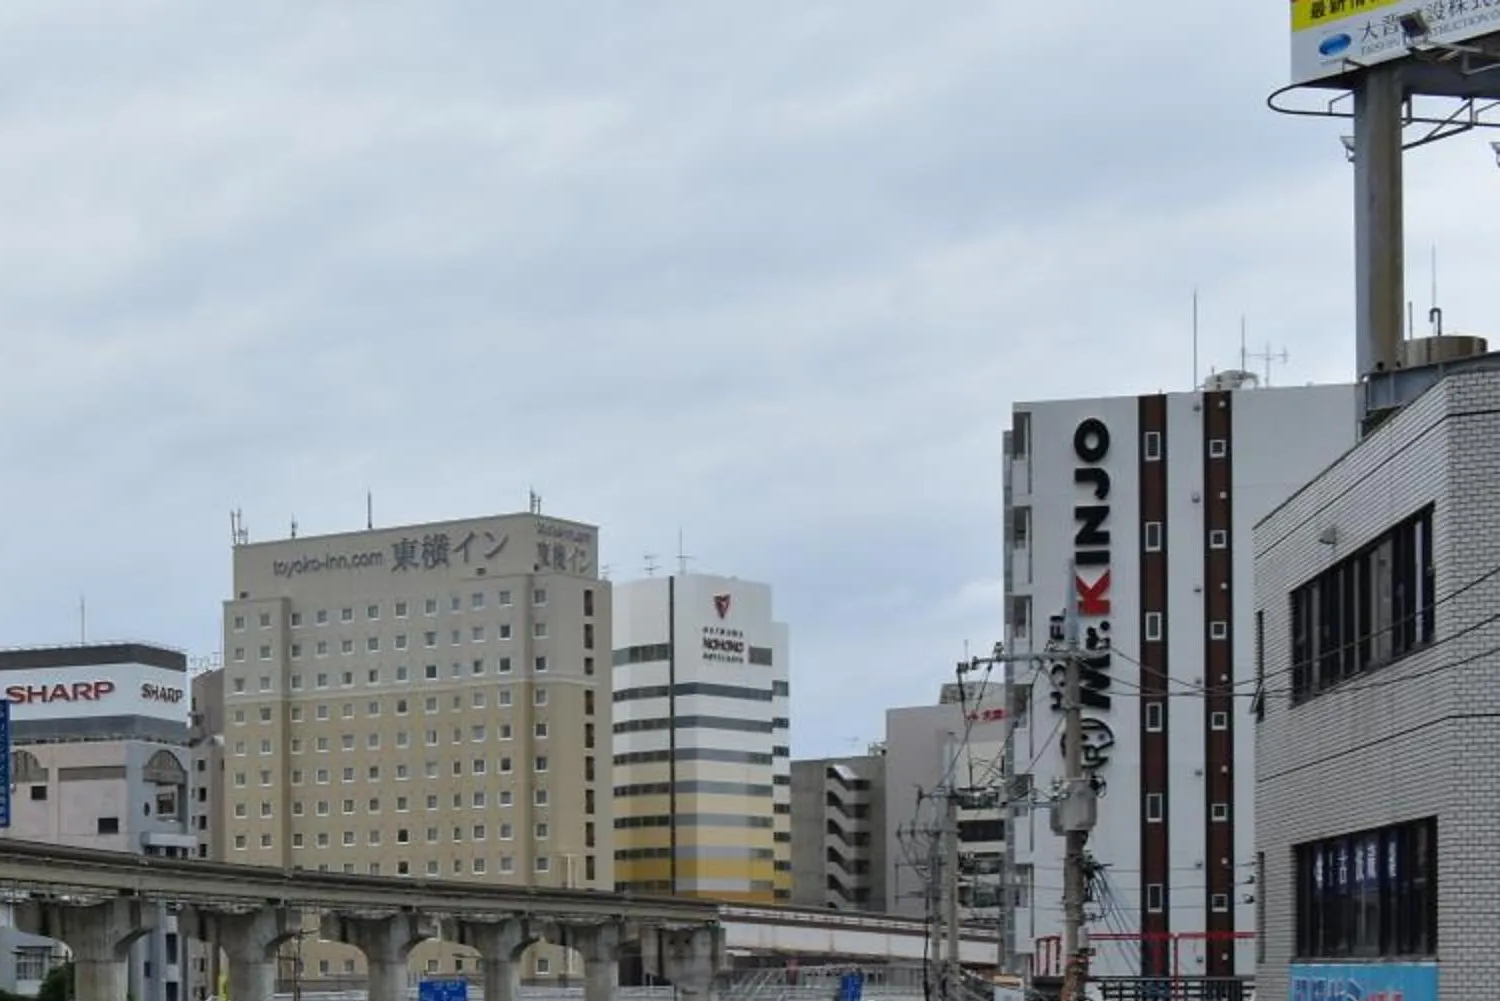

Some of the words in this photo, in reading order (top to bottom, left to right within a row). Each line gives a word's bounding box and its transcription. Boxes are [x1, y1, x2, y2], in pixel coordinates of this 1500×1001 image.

[272, 550, 384, 579] toyoko-inn.com
[390, 530, 510, 574] 東横イン
[5, 681, 115, 705] SHARP
[140, 682, 184, 704] SHARP
